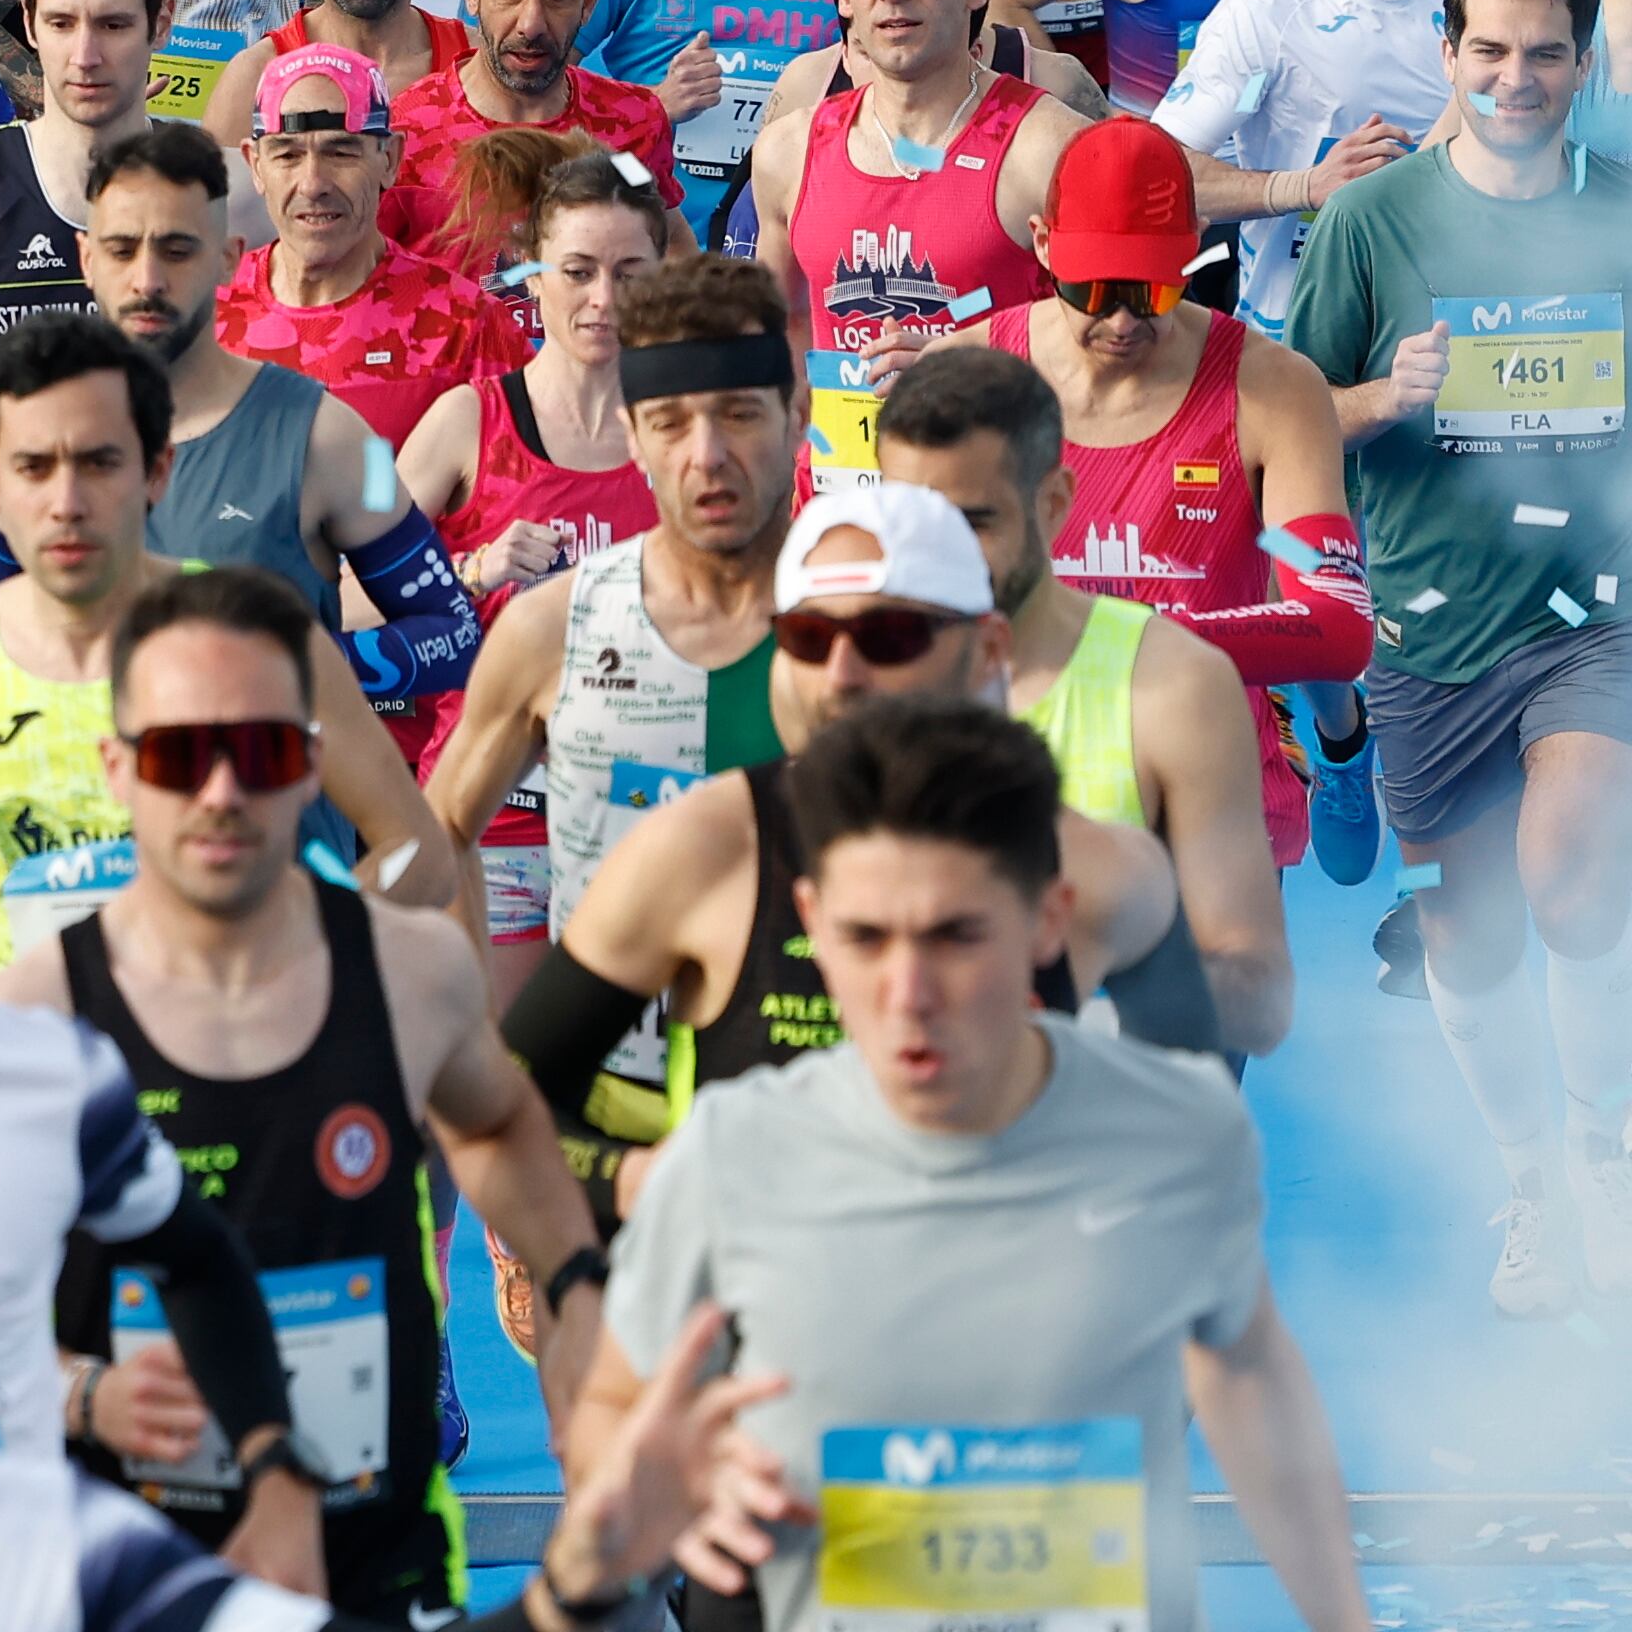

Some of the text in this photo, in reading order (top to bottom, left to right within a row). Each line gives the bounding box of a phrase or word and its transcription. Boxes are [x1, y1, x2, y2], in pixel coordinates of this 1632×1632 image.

[170, 35, 222, 51] Movistar
[278, 55, 350, 78] LOS LUNES
[1521, 305, 1588, 322] Movistar
[834, 325, 872, 351] LOS
[1492, 355, 1565, 384] 1461
[1510, 412, 1551, 430] FLA
[1453, 438, 1504, 454] Joma
[1175, 503, 1217, 523] Tony
[920, 1527, 1051, 1574] 1733
